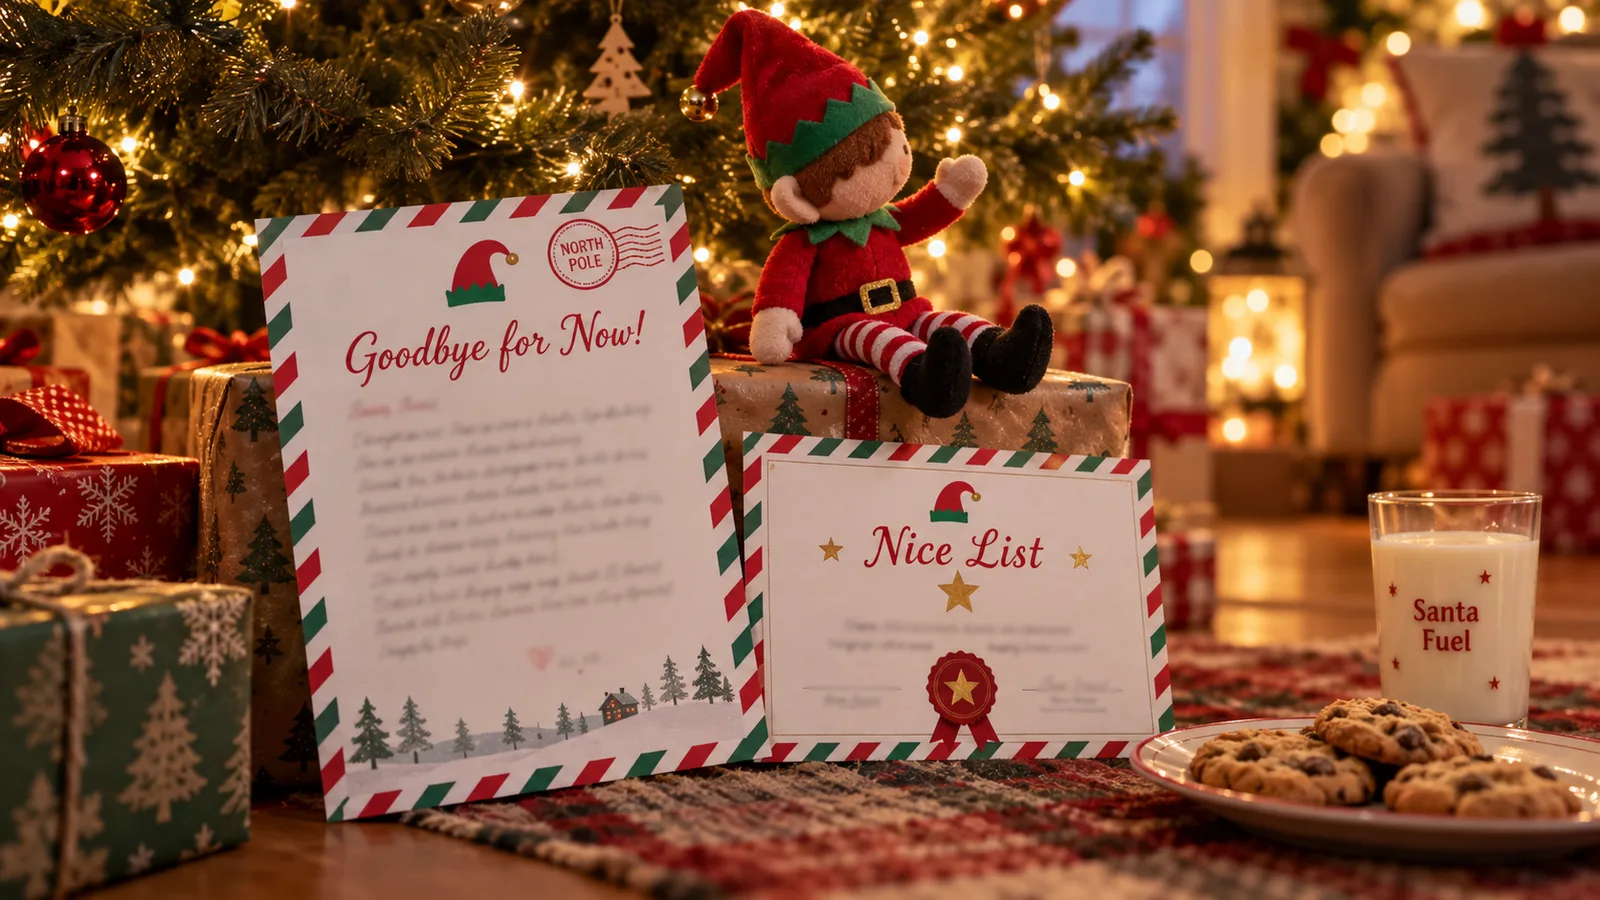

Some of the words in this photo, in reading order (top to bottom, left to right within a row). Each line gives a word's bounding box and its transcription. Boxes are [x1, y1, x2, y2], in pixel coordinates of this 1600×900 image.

[560, 237, 604, 256] NORTH
[568, 254, 603, 272] POLE
[345, 324, 490, 387] Goodbye
[499, 319, 550, 373] for
[559, 310, 646, 356] Now!
[864, 525, 953, 568] Nice
[965, 527, 1044, 569] List
[1413, 598, 1479, 623] Santa
[1422, 628, 1471, 652] Fuel
